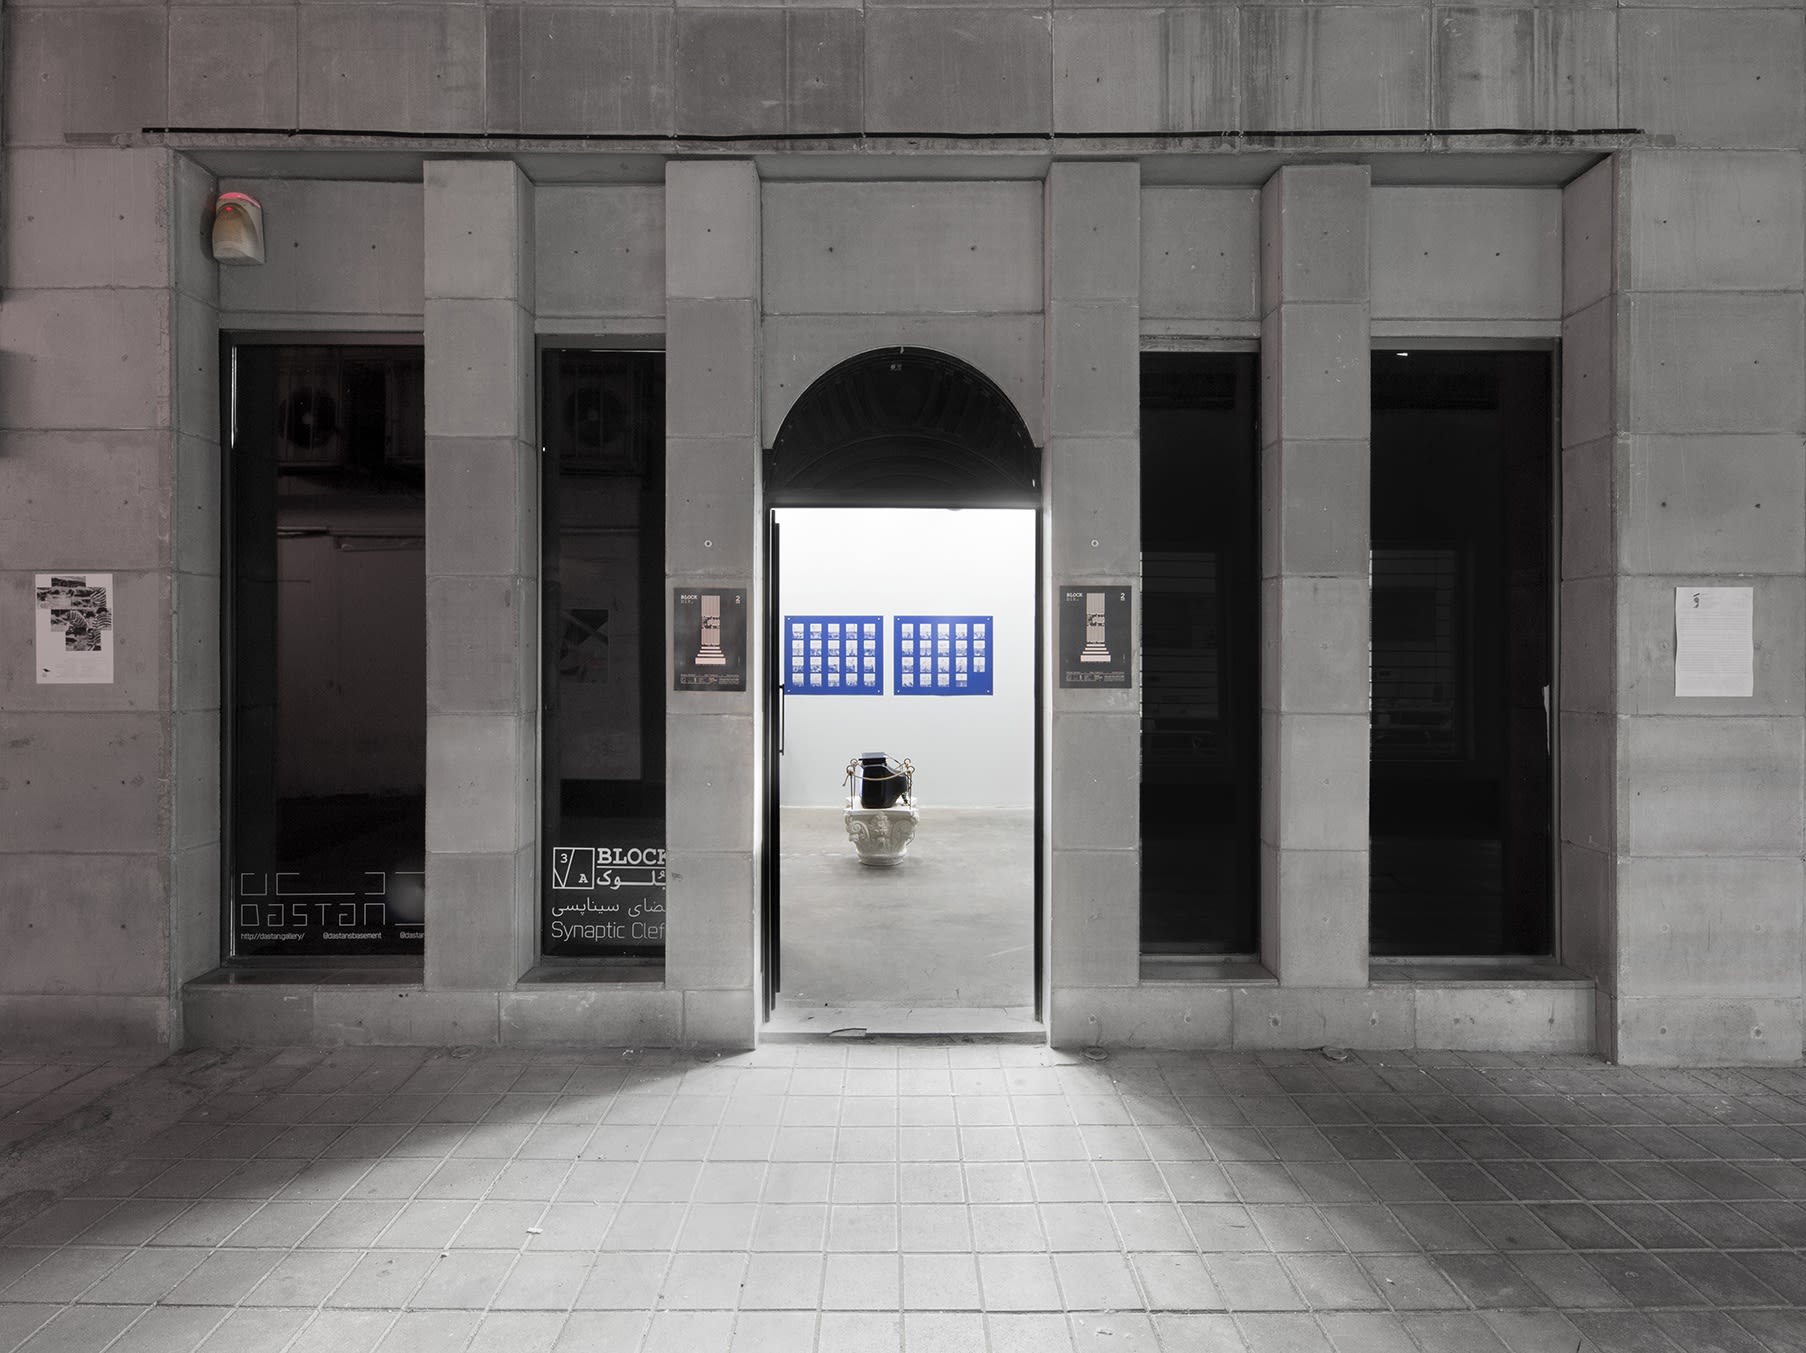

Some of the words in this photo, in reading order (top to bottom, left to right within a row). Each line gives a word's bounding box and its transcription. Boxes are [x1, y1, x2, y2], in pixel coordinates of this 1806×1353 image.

[560, 853, 568, 863] 3
[597, 848, 666, 865] BLOCK
[578, 873, 588, 883] A
[628, 897, 666, 917] ضای
[551, 920, 625, 942] Synaptic
[632, 922, 665, 939] Clef
